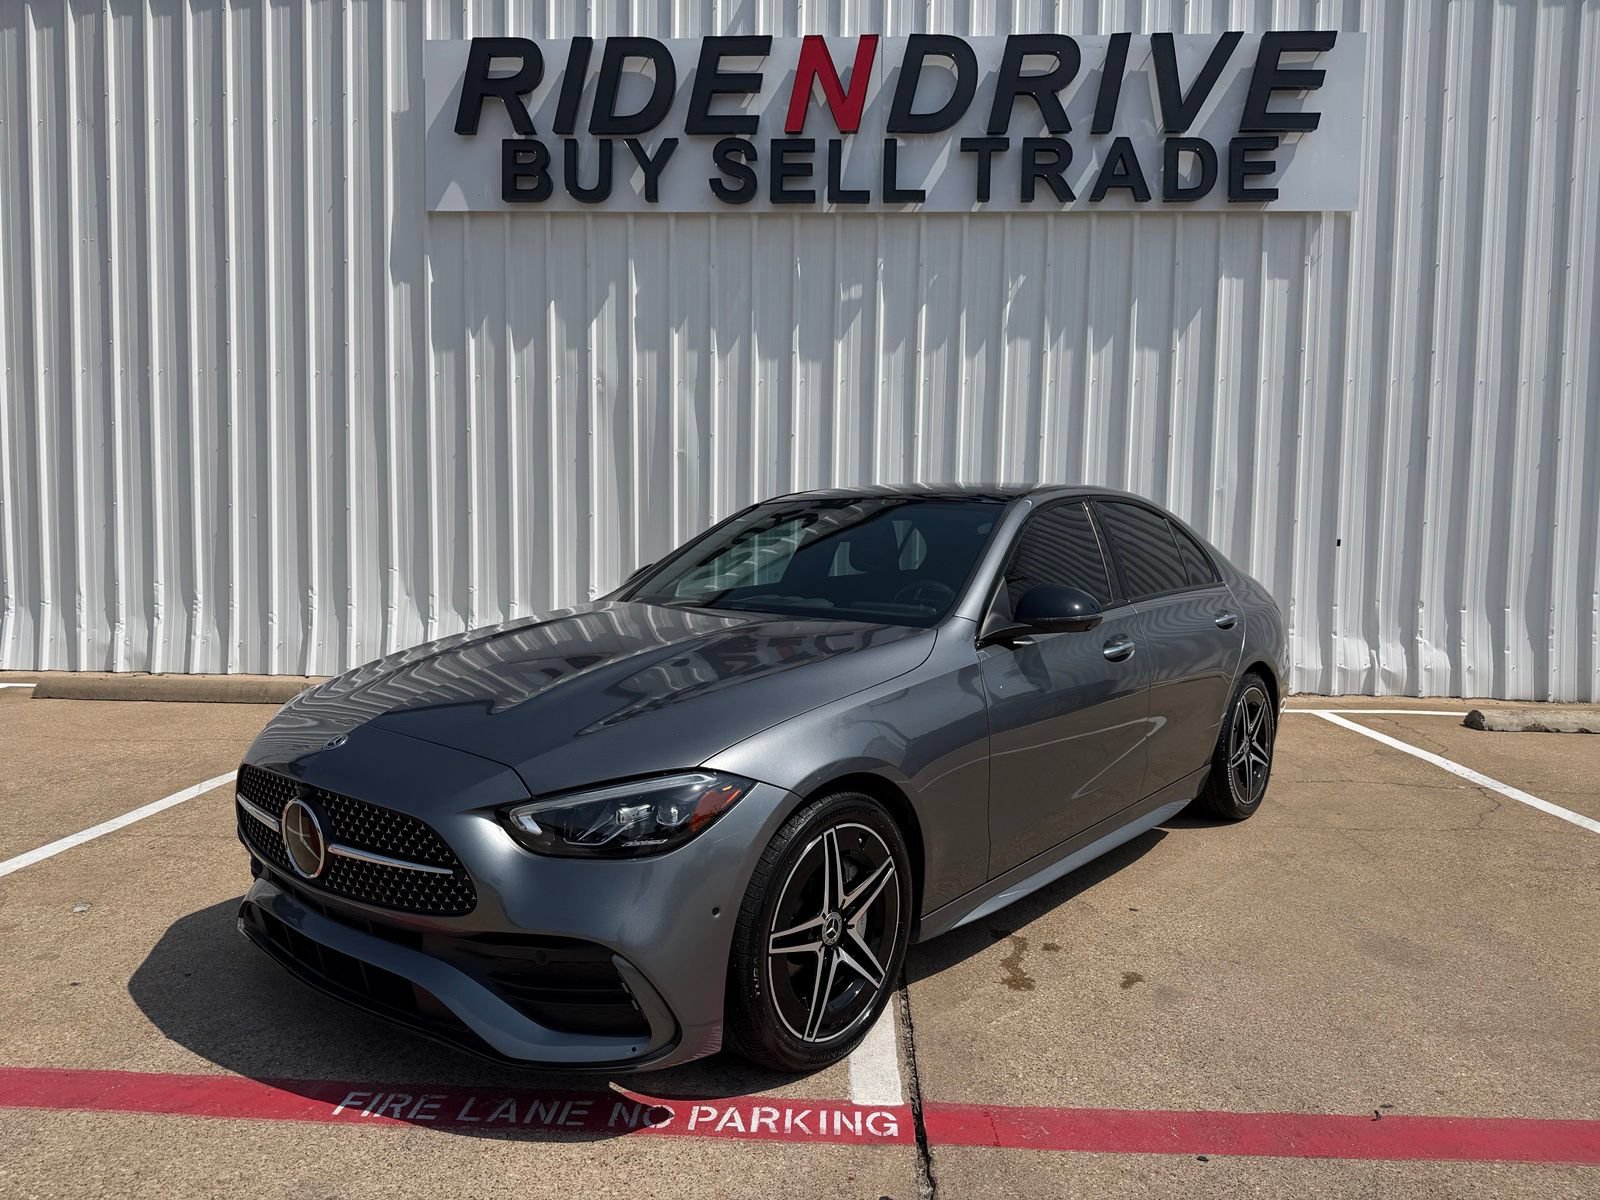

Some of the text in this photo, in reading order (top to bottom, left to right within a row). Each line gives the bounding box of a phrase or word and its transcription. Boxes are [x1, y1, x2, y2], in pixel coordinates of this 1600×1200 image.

[501, 136, 1279, 204] BUY SELL TRADE
[331, 1091, 899, 1137] FIRE LANE NO PARKING
